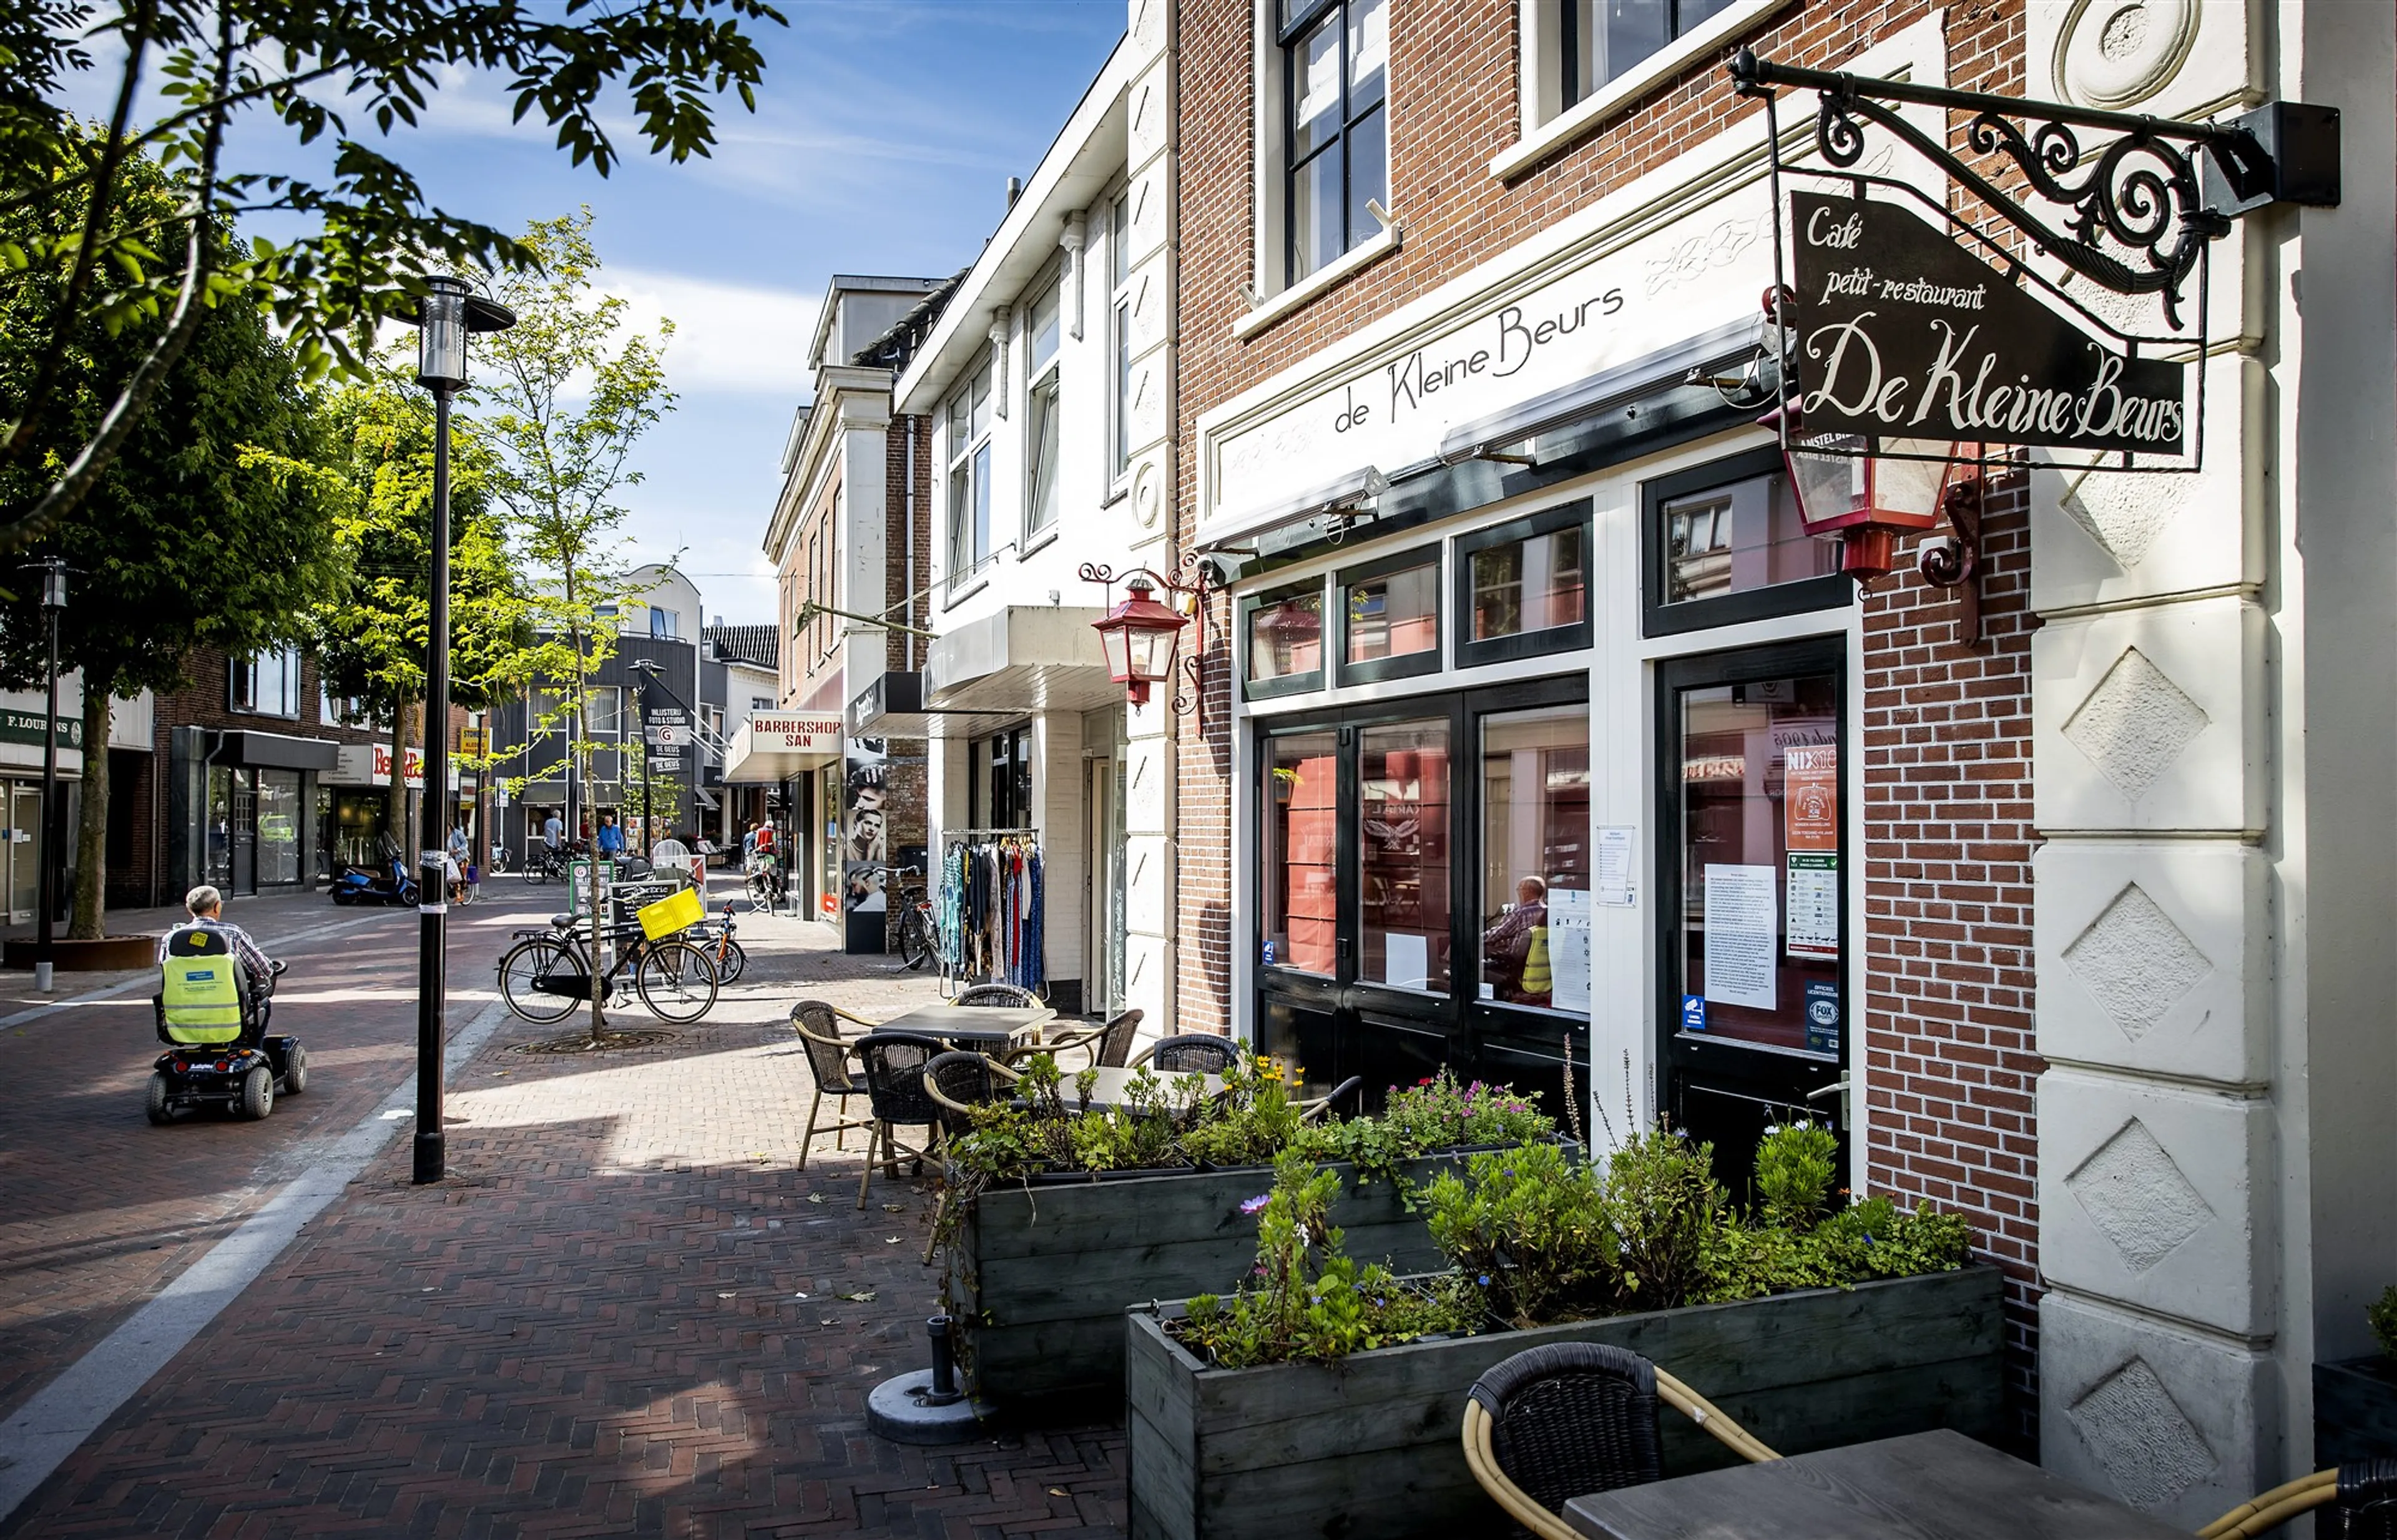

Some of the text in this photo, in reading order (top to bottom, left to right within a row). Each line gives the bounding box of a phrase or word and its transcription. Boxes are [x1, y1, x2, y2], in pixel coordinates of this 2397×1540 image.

[1807, 206, 1863, 249] Café
[1335, 287, 1624, 433] de Kleine Beurs
[1802, 311, 2184, 442] De Kleine Beurs
[1801, 433, 1855, 447] AMSTEL BI
[755, 720, 841, 733] BARBERSHOP
[785, 735, 811, 747] SAN
[1815, 1005, 1832, 1016] FOX
